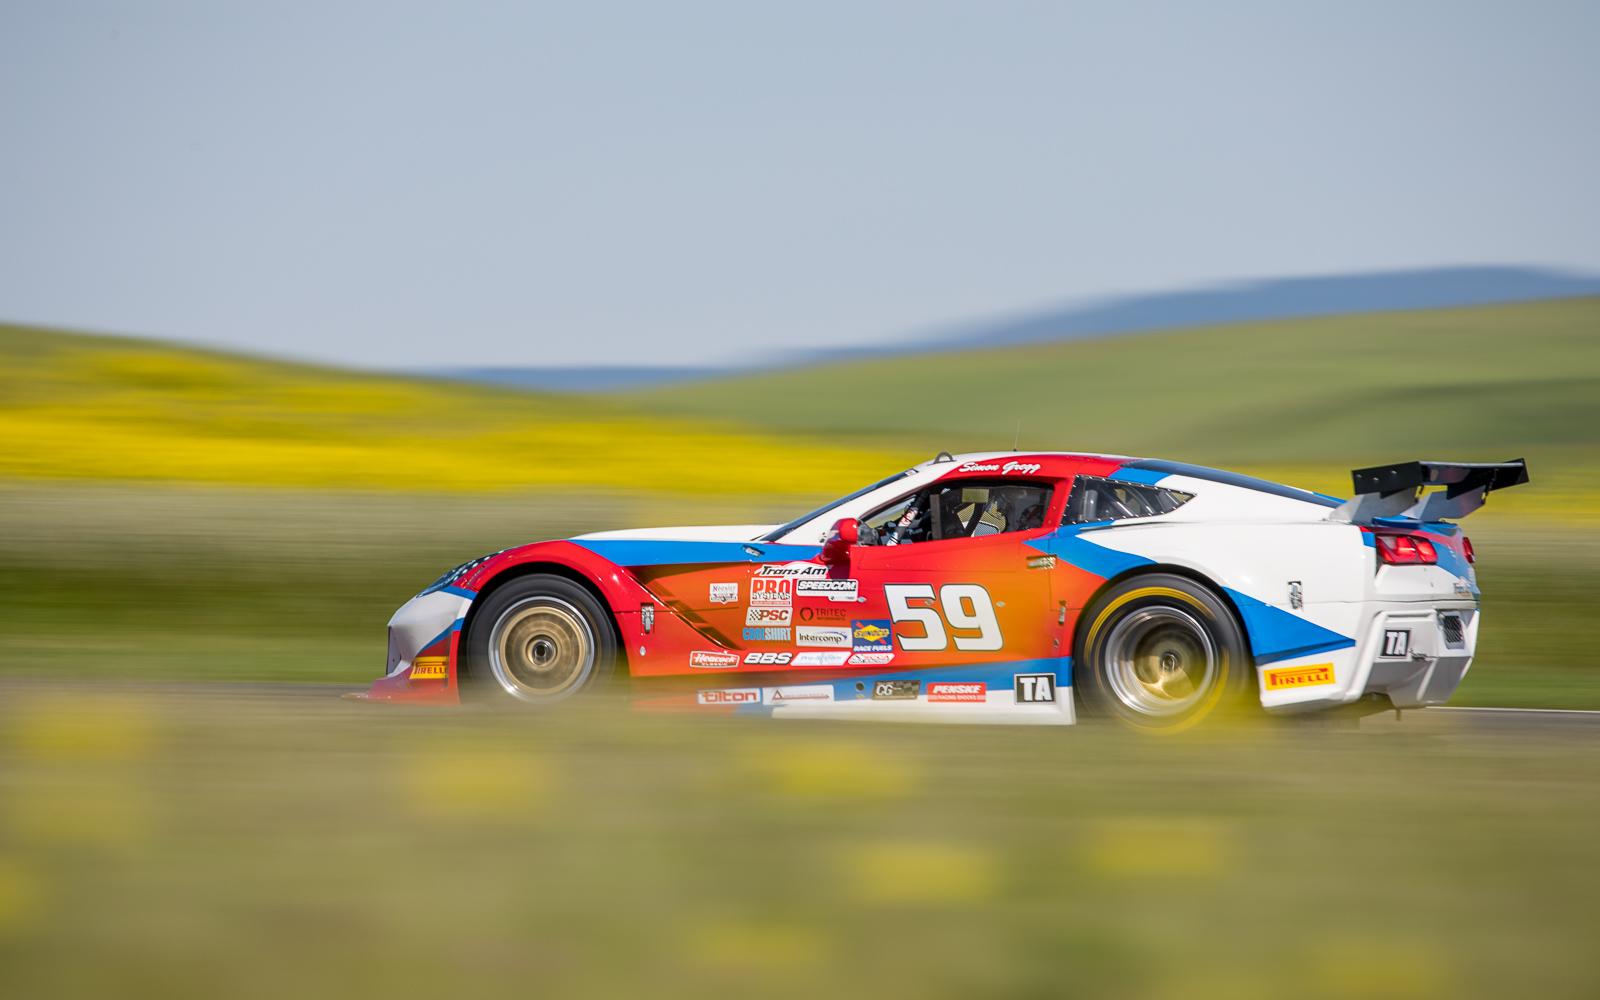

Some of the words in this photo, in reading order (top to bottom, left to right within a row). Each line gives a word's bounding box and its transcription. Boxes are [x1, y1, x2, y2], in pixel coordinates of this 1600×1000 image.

[959, 461, 1000, 473] Simon
[1002, 461, 1041, 475] Gregg
[761, 565, 798, 576] Trans
[800, 565, 828, 576] Am
[752, 579, 790, 593] PRO
[798, 580, 857, 591] SPEEDCOM
[759, 609, 789, 621] PSC
[815, 608, 847, 617] TRITEC
[884, 584, 1003, 651] 59
[798, 632, 843, 646] Intercomp
[1385, 631, 1408, 656] TA
[744, 652, 793, 665] BBS
[1269, 668, 1330, 687] PIRELLI
[875, 685, 894, 697] CG
[1019, 676, 1053, 702] TA
[704, 691, 757, 702] tilton
